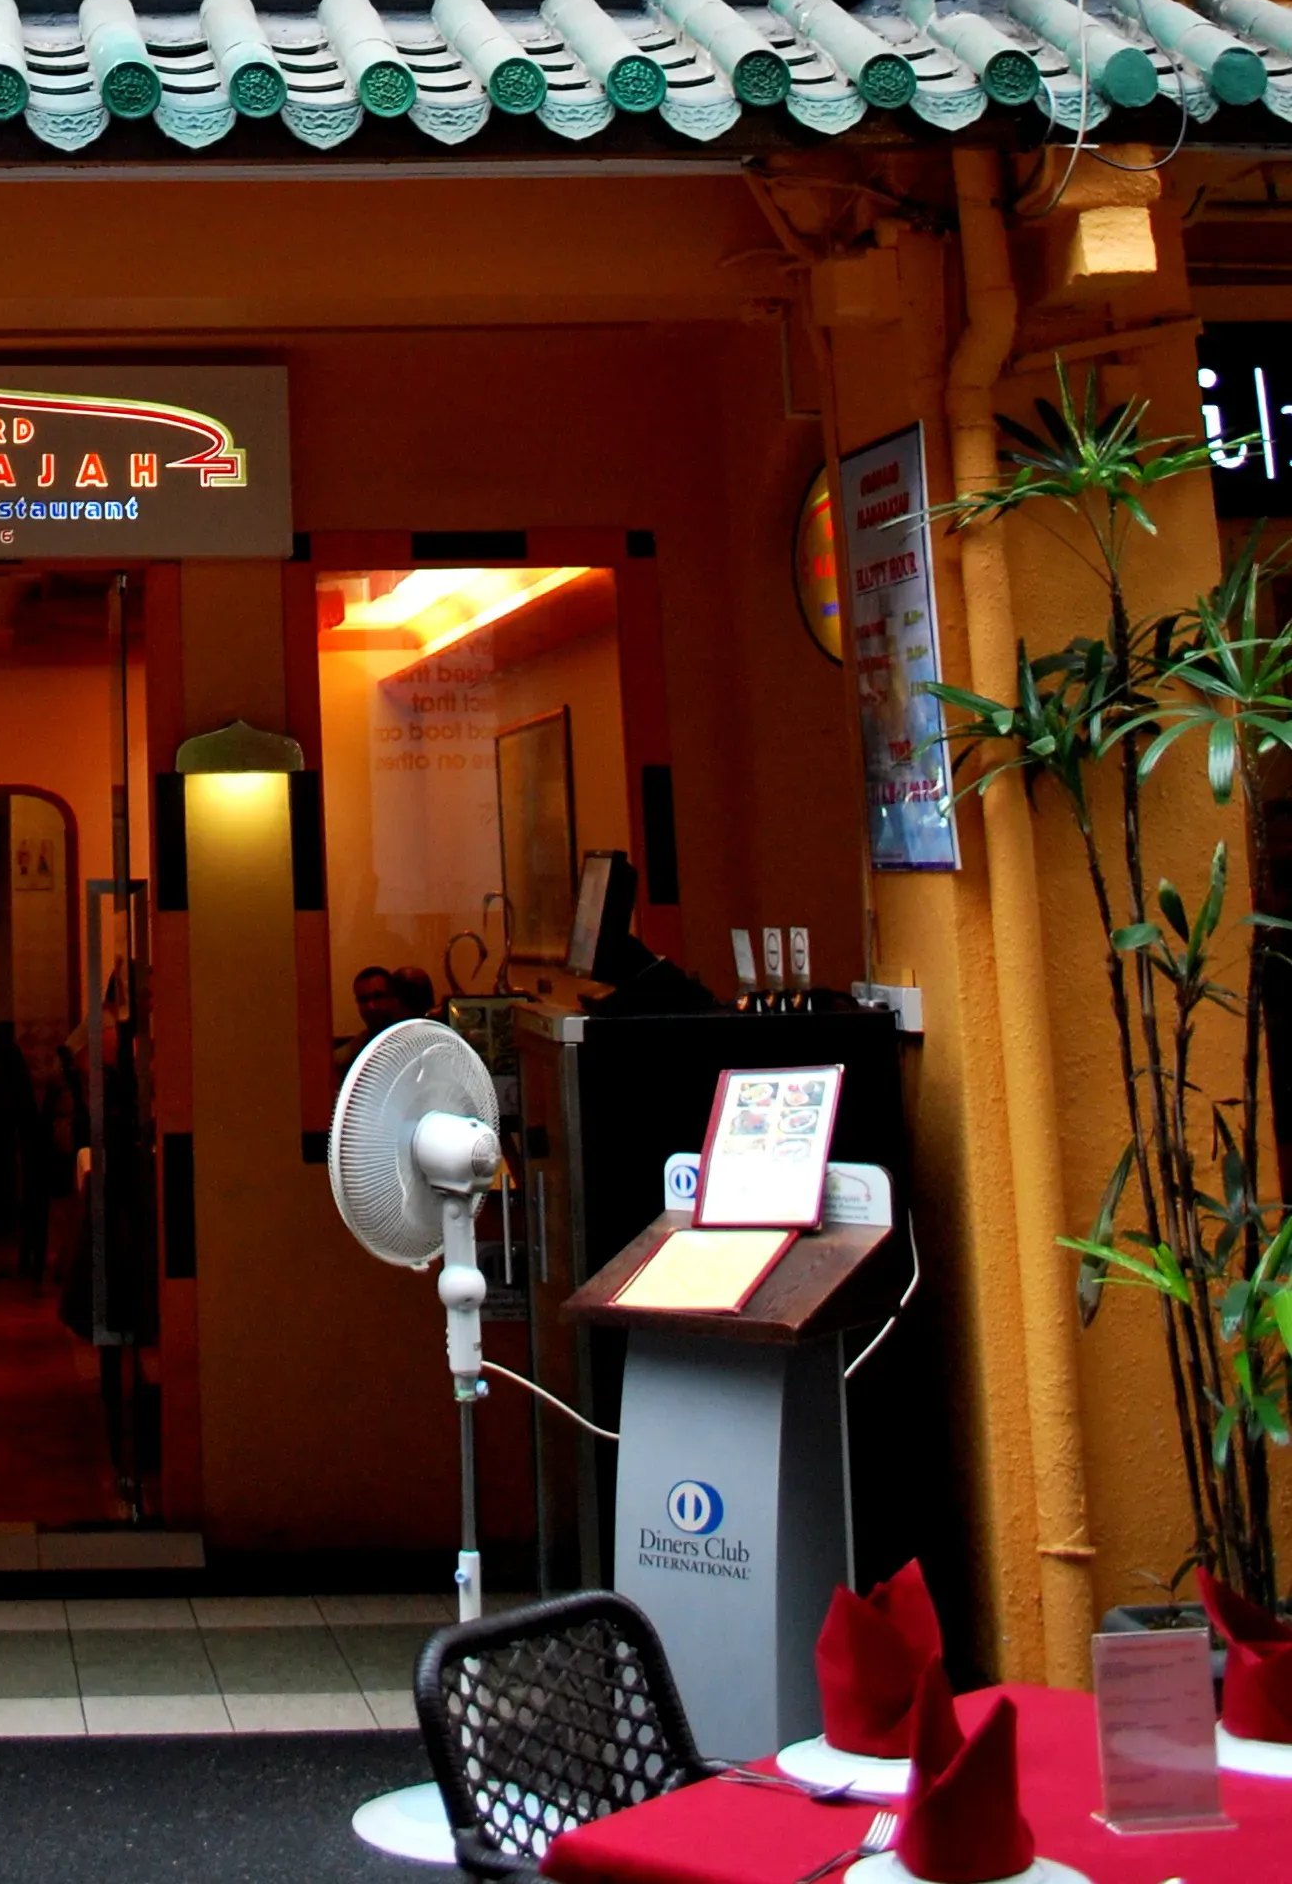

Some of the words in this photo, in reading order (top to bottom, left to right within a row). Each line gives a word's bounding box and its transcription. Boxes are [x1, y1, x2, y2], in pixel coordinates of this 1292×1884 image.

[855, 560, 888, 592] HAPPY
[889, 551, 919, 582] HOUR
[640, 1528, 699, 1556] Diners
[704, 1537, 749, 1562] Club
[638, 1553, 750, 1579] INTERNATIONAL
